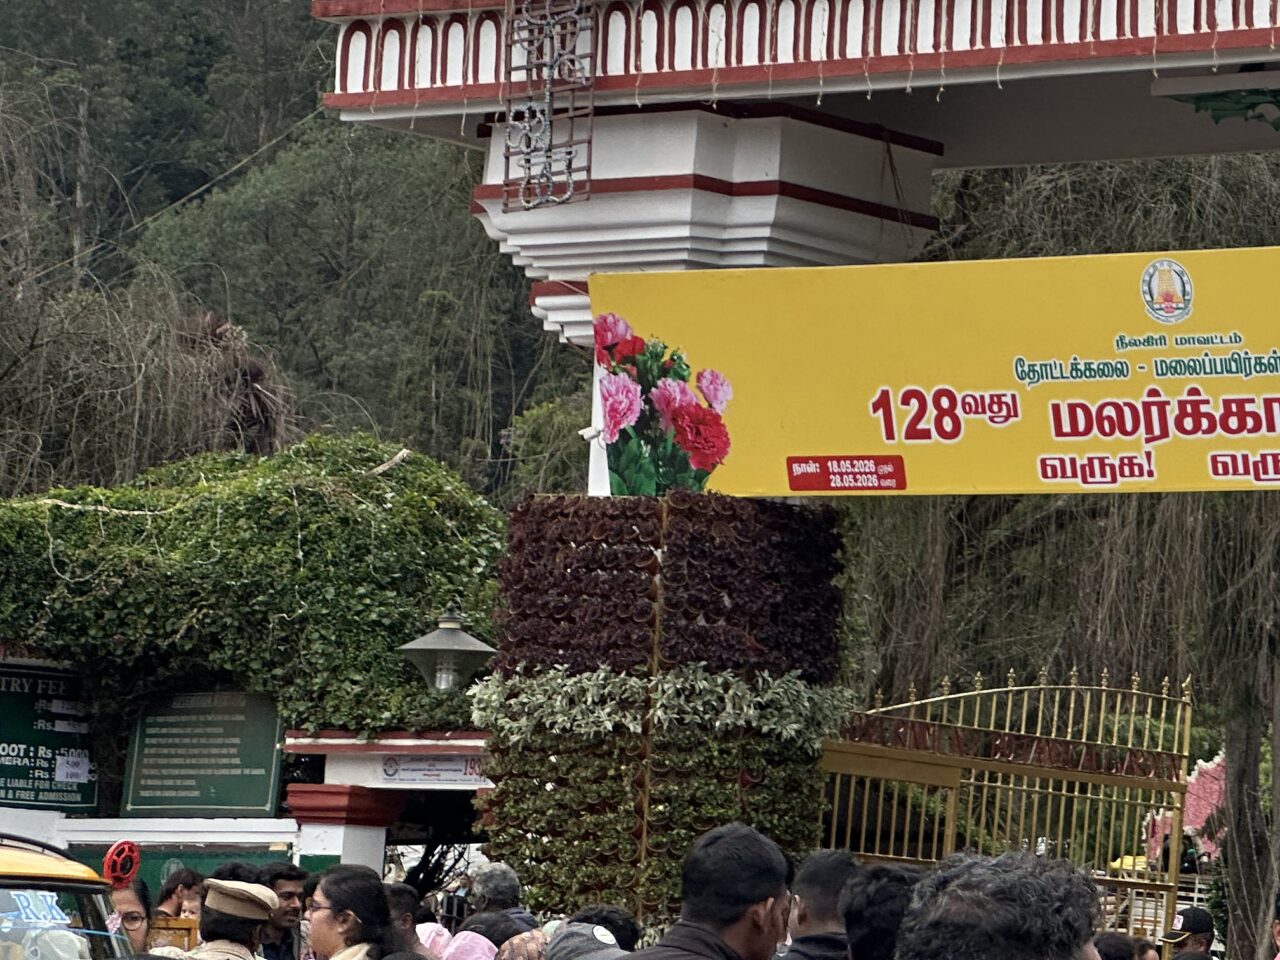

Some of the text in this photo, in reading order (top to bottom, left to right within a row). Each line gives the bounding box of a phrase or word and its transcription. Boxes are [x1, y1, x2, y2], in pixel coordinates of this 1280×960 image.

[1115, 331, 1243, 350] நீலகிரி மாவட்டம்
[1014, 356, 1130, 385] தோட்டக்கலை
[827, 460, 876, 473] 18.05.2026
[1040, 450, 1155, 485] வருக!
[829, 474, 879, 487] 28.05.2026
